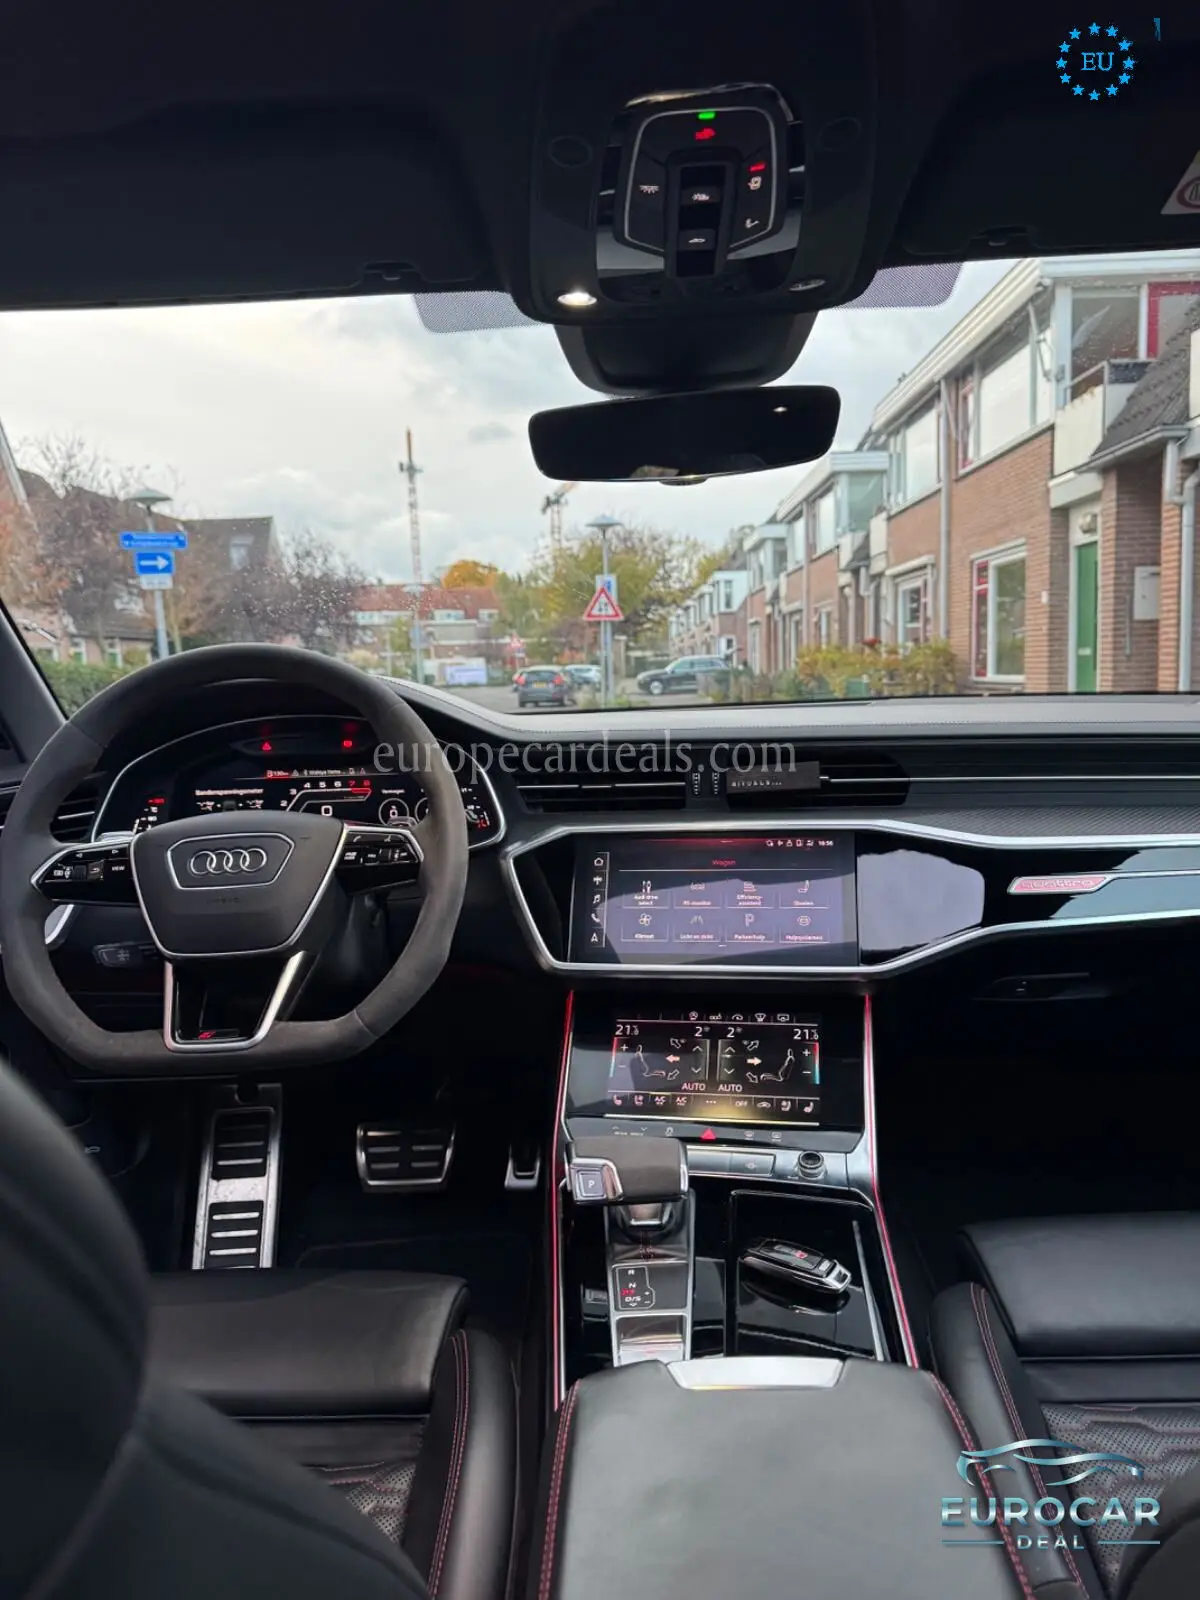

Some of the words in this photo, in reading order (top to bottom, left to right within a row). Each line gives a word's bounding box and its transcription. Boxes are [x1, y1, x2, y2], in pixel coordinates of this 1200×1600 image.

[712, 859, 736, 868] Wagen
[694, 1026, 703, 1037] 2
[726, 1026, 735, 1038] 2
[681, 1082, 706, 1091] AUTO
[718, 1083, 743, 1092] AUTO
[588, 1180, 595, 1188] P
